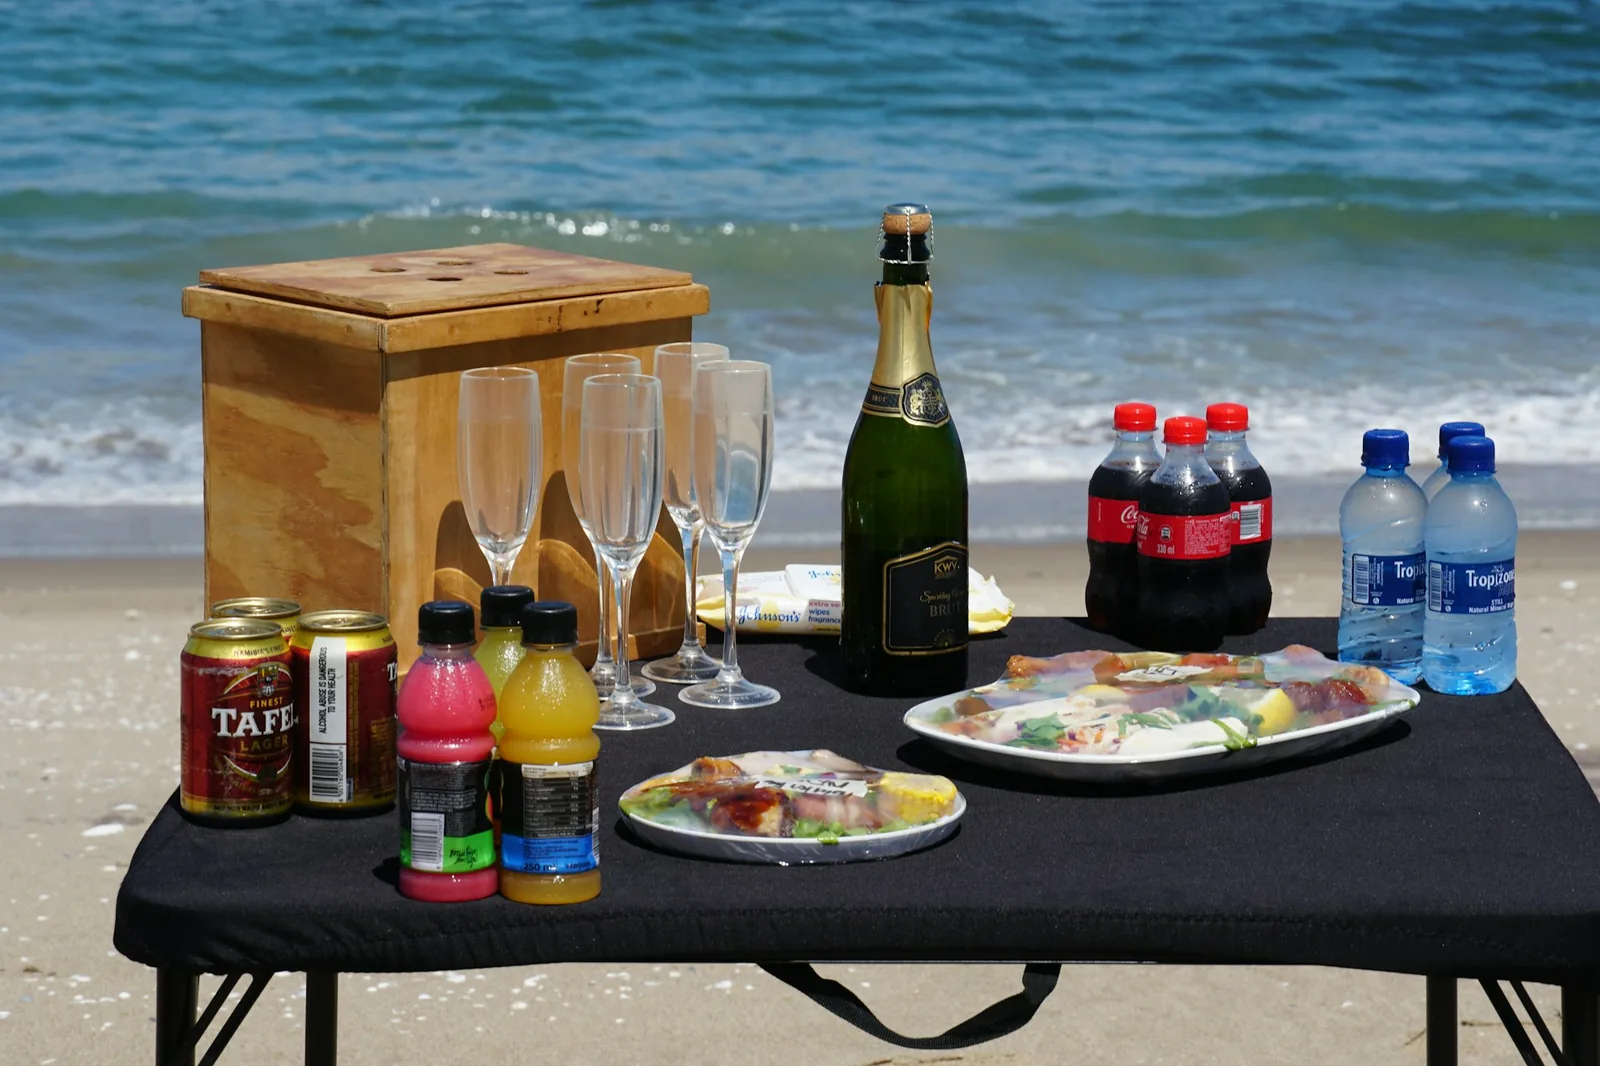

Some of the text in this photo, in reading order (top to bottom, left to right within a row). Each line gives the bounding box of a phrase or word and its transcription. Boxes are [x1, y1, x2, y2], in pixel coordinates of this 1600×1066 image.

[1156, 543, 1167, 555] 330
[1167, 544, 1176, 555] ml
[934, 560, 958, 575] KWV
[808, 600, 830, 608] extra
[1468, 606, 1489, 614] Natural
[1490, 598, 1504, 607] STILL
[738, 604, 801, 625] Johnson's
[808, 608, 831, 617] wipes
[929, 602, 961, 619] BRUT
[233, 646, 270, 657] NAMIBIA'S
[318, 646, 327, 681] DANGEROUS
[327, 668, 336, 689] HEALTH
[250, 696, 283, 709] FINEST
[318, 688, 327, 707] ABUSE
[327, 689, 336, 705] YOUR
[318, 708, 327, 735] ALCOHOL
[240, 735, 289, 752] LAGER
[523, 862, 541, 871] 250
